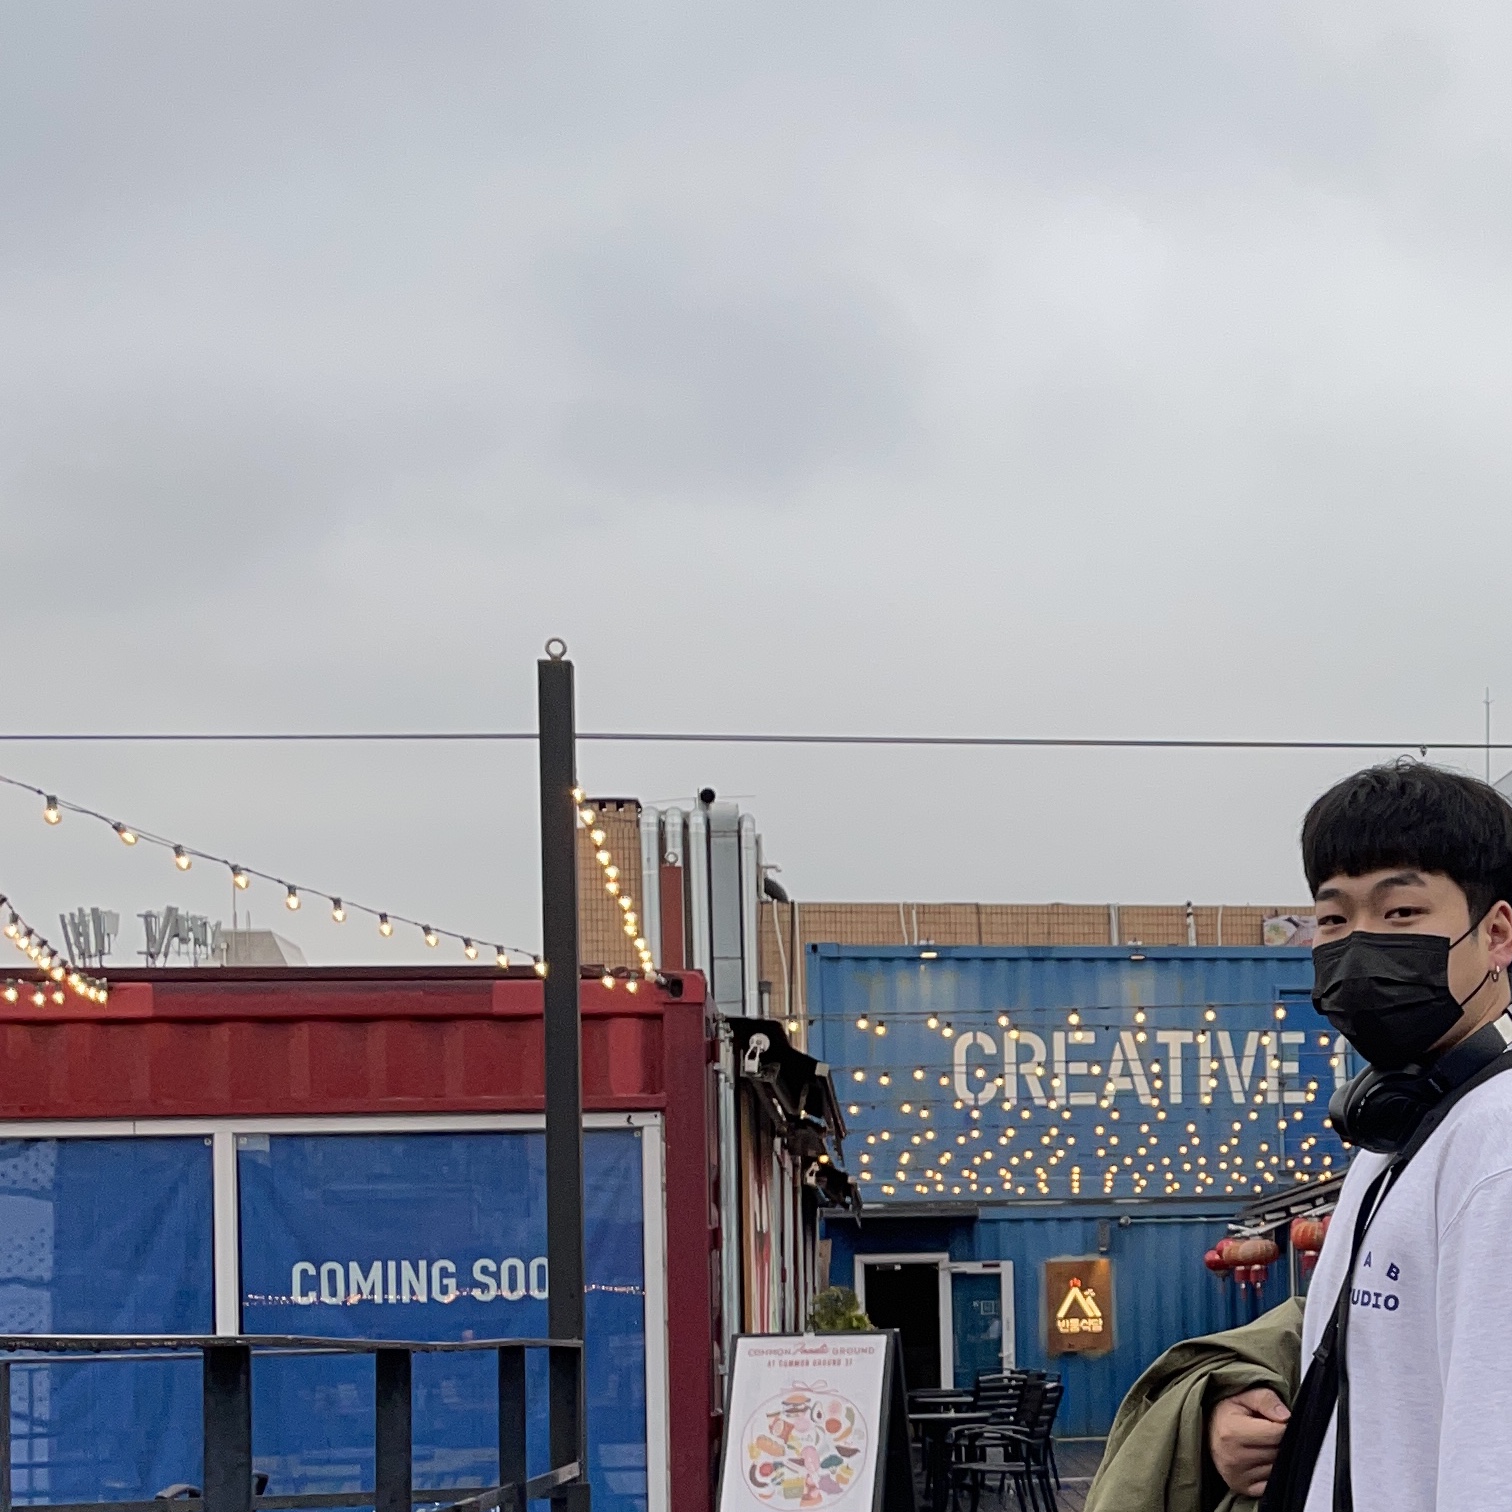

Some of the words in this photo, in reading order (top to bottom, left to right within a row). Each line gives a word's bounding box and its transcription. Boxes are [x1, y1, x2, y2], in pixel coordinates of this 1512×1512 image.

[953, 1030, 1305, 1106] CREATIVE
[291, 1259, 457, 1306] COMING
[472, 1256, 549, 1302] SOO
[832, 1346, 876, 1356] GROUND
